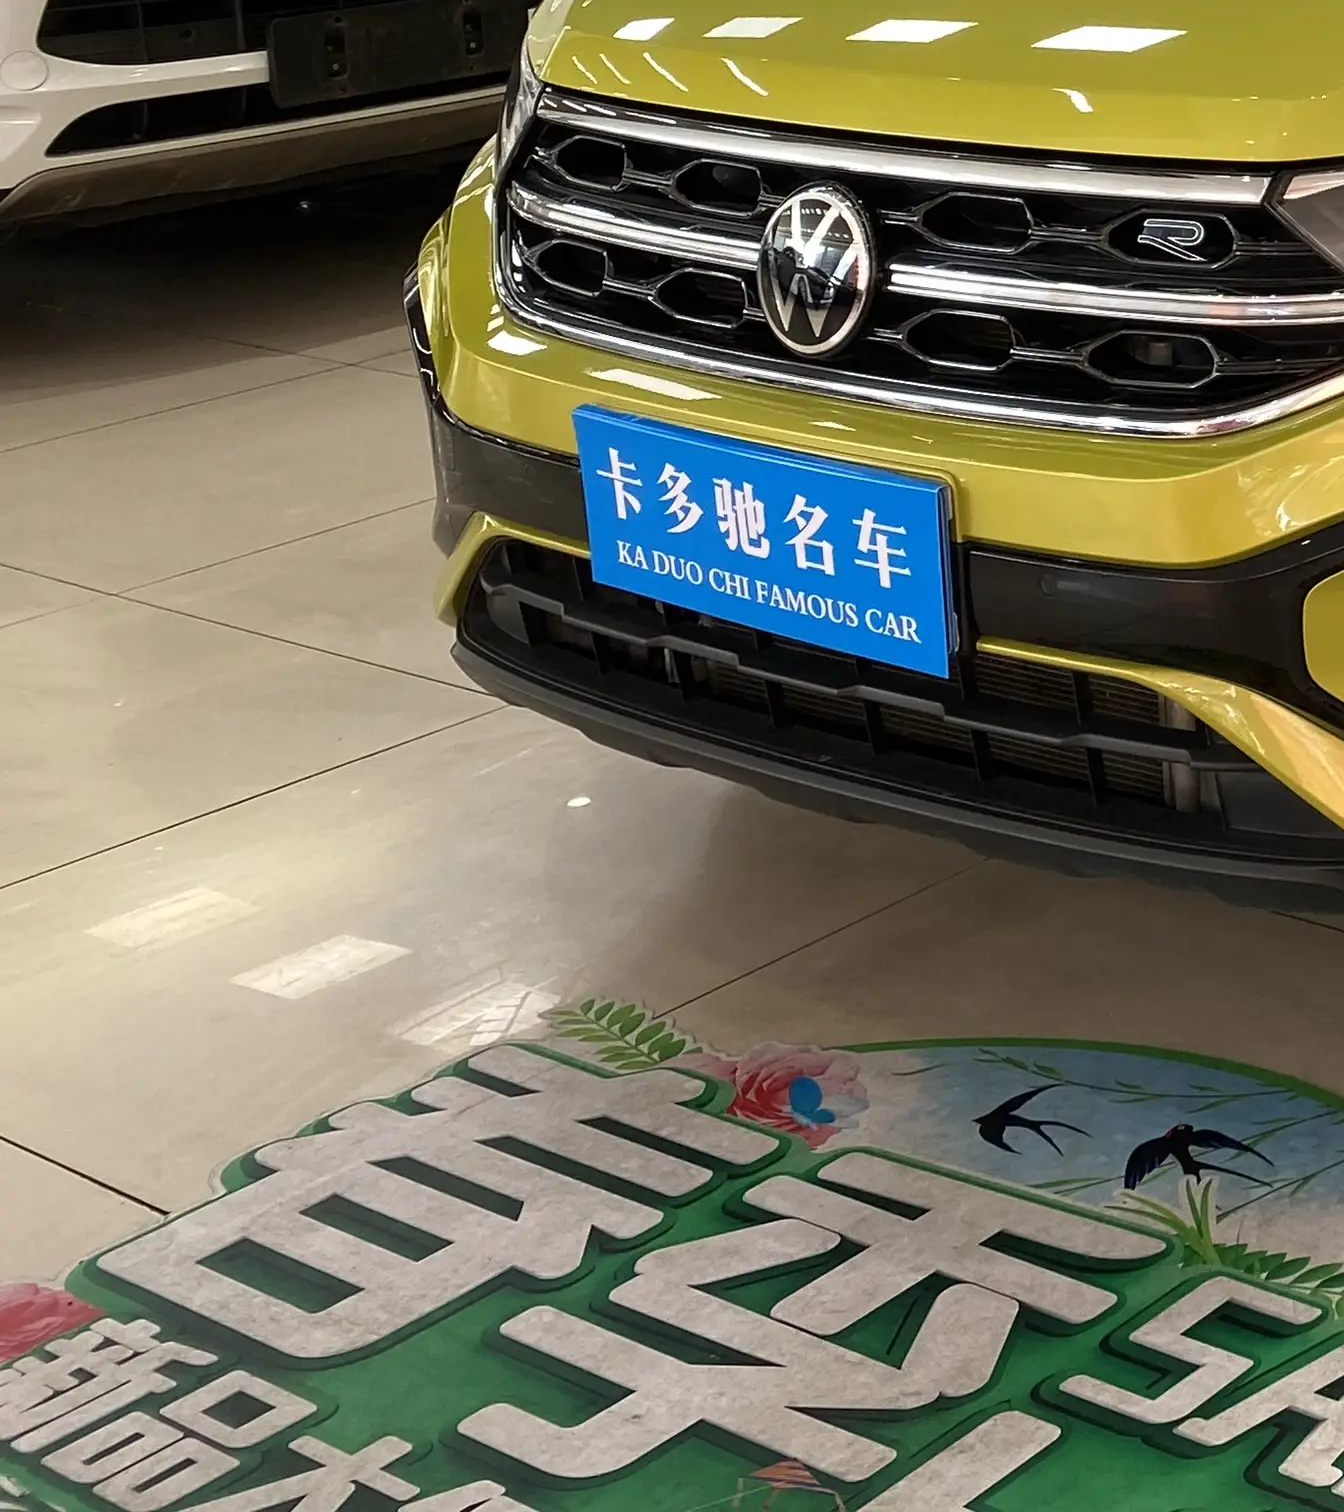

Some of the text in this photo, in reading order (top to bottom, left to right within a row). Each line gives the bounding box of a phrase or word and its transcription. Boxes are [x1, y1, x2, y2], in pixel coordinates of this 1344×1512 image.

[595, 447, 912, 589] 卡多驰名车
[616, 539, 922, 644] KA DUO CHI FAMOUS CAR
